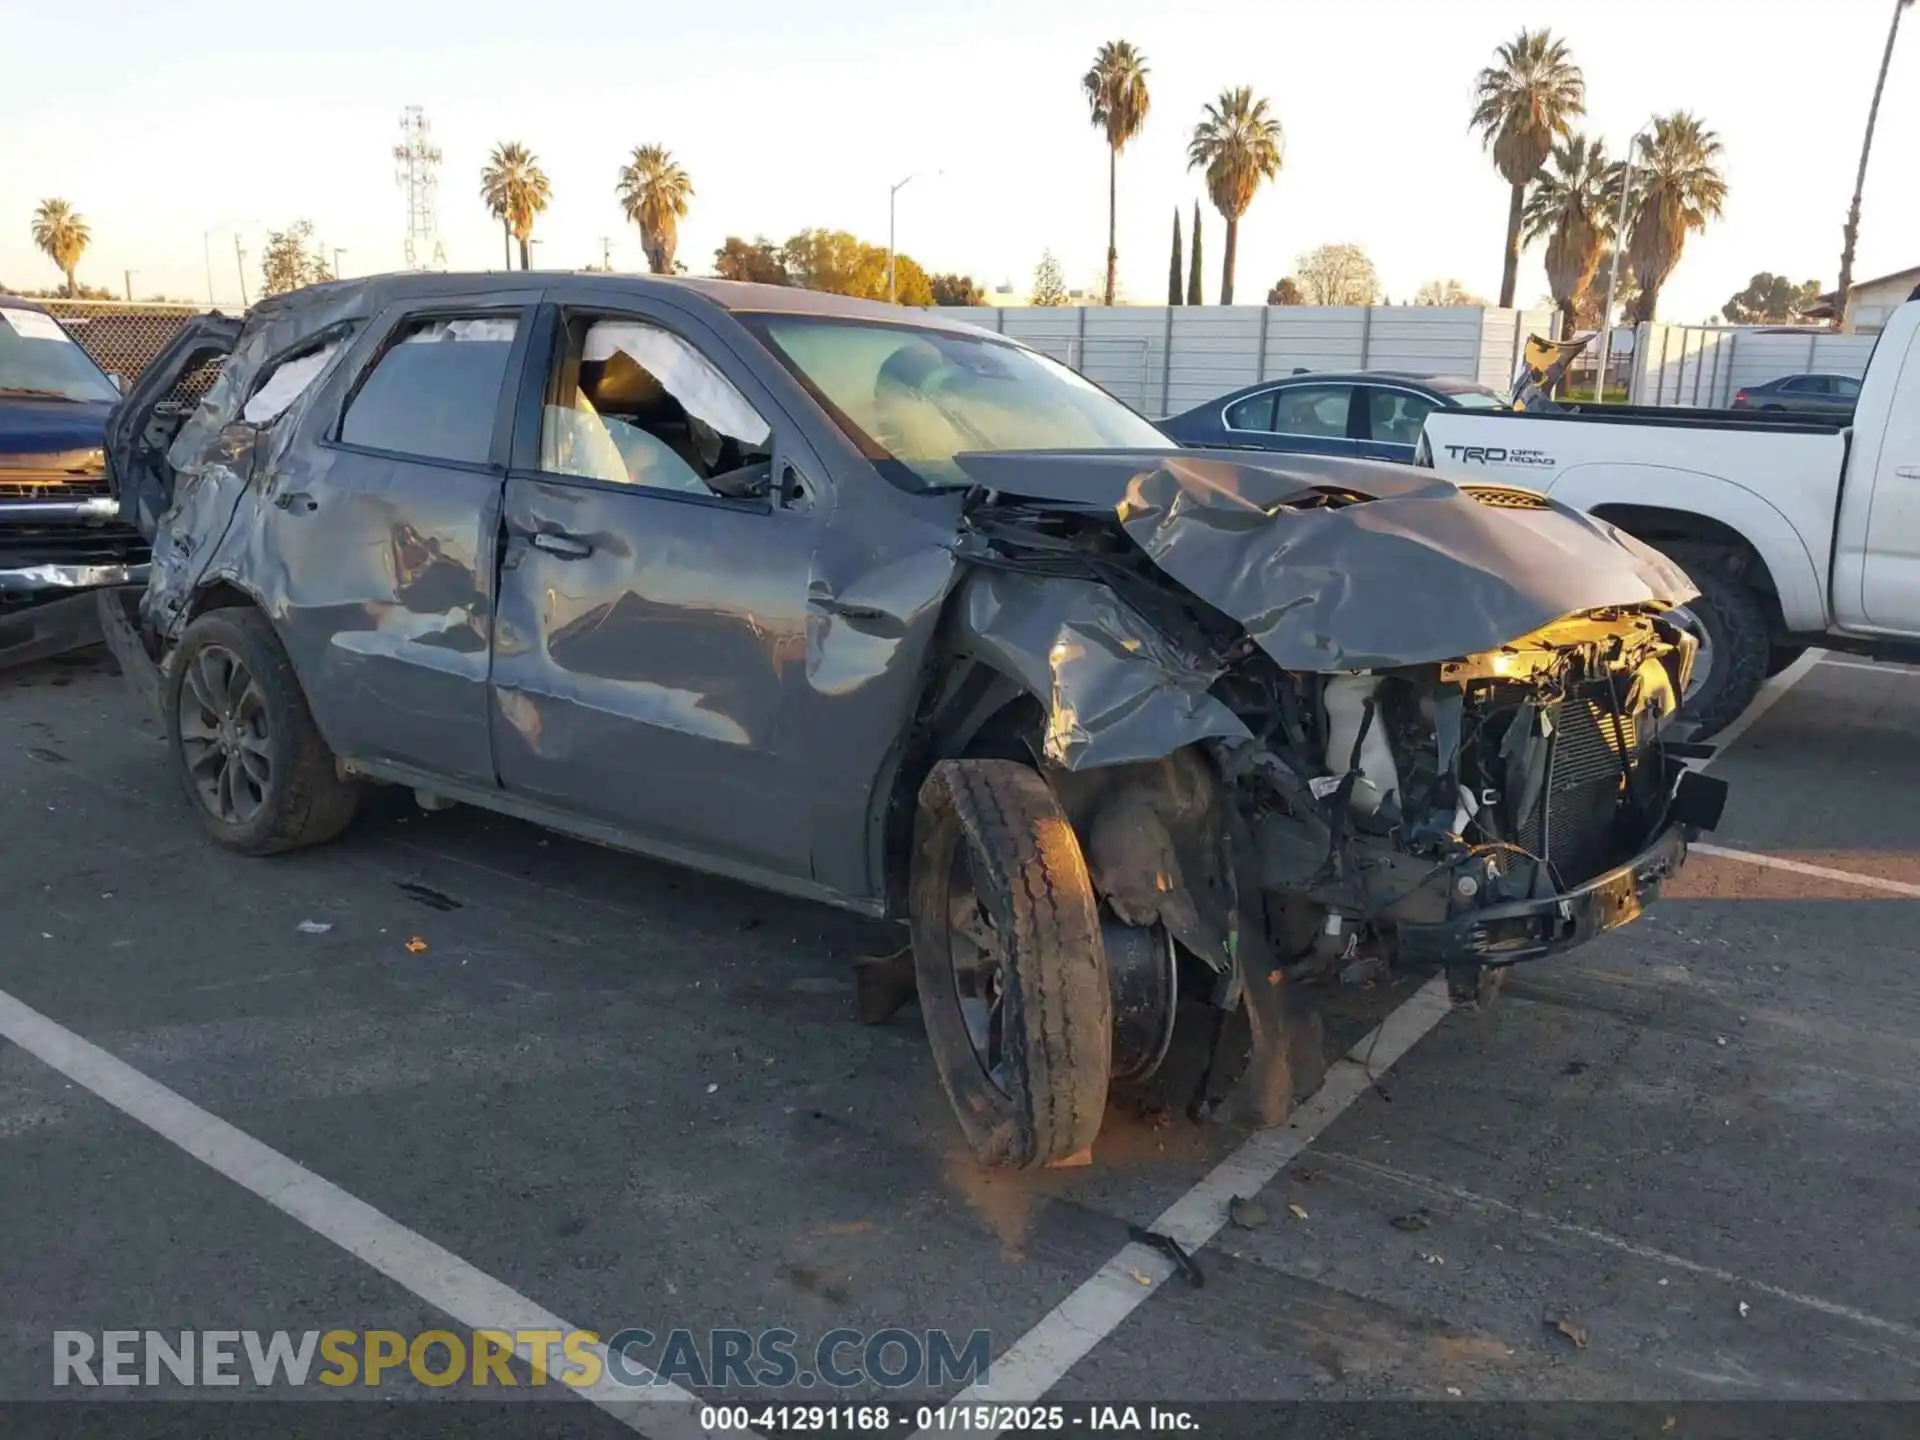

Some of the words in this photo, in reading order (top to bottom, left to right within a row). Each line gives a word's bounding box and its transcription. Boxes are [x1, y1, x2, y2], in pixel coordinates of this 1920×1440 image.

[1444, 445, 1506, 465] TRD
[1510, 449, 1544, 457] OFF
[1509, 456, 1556, 466] ROAD
